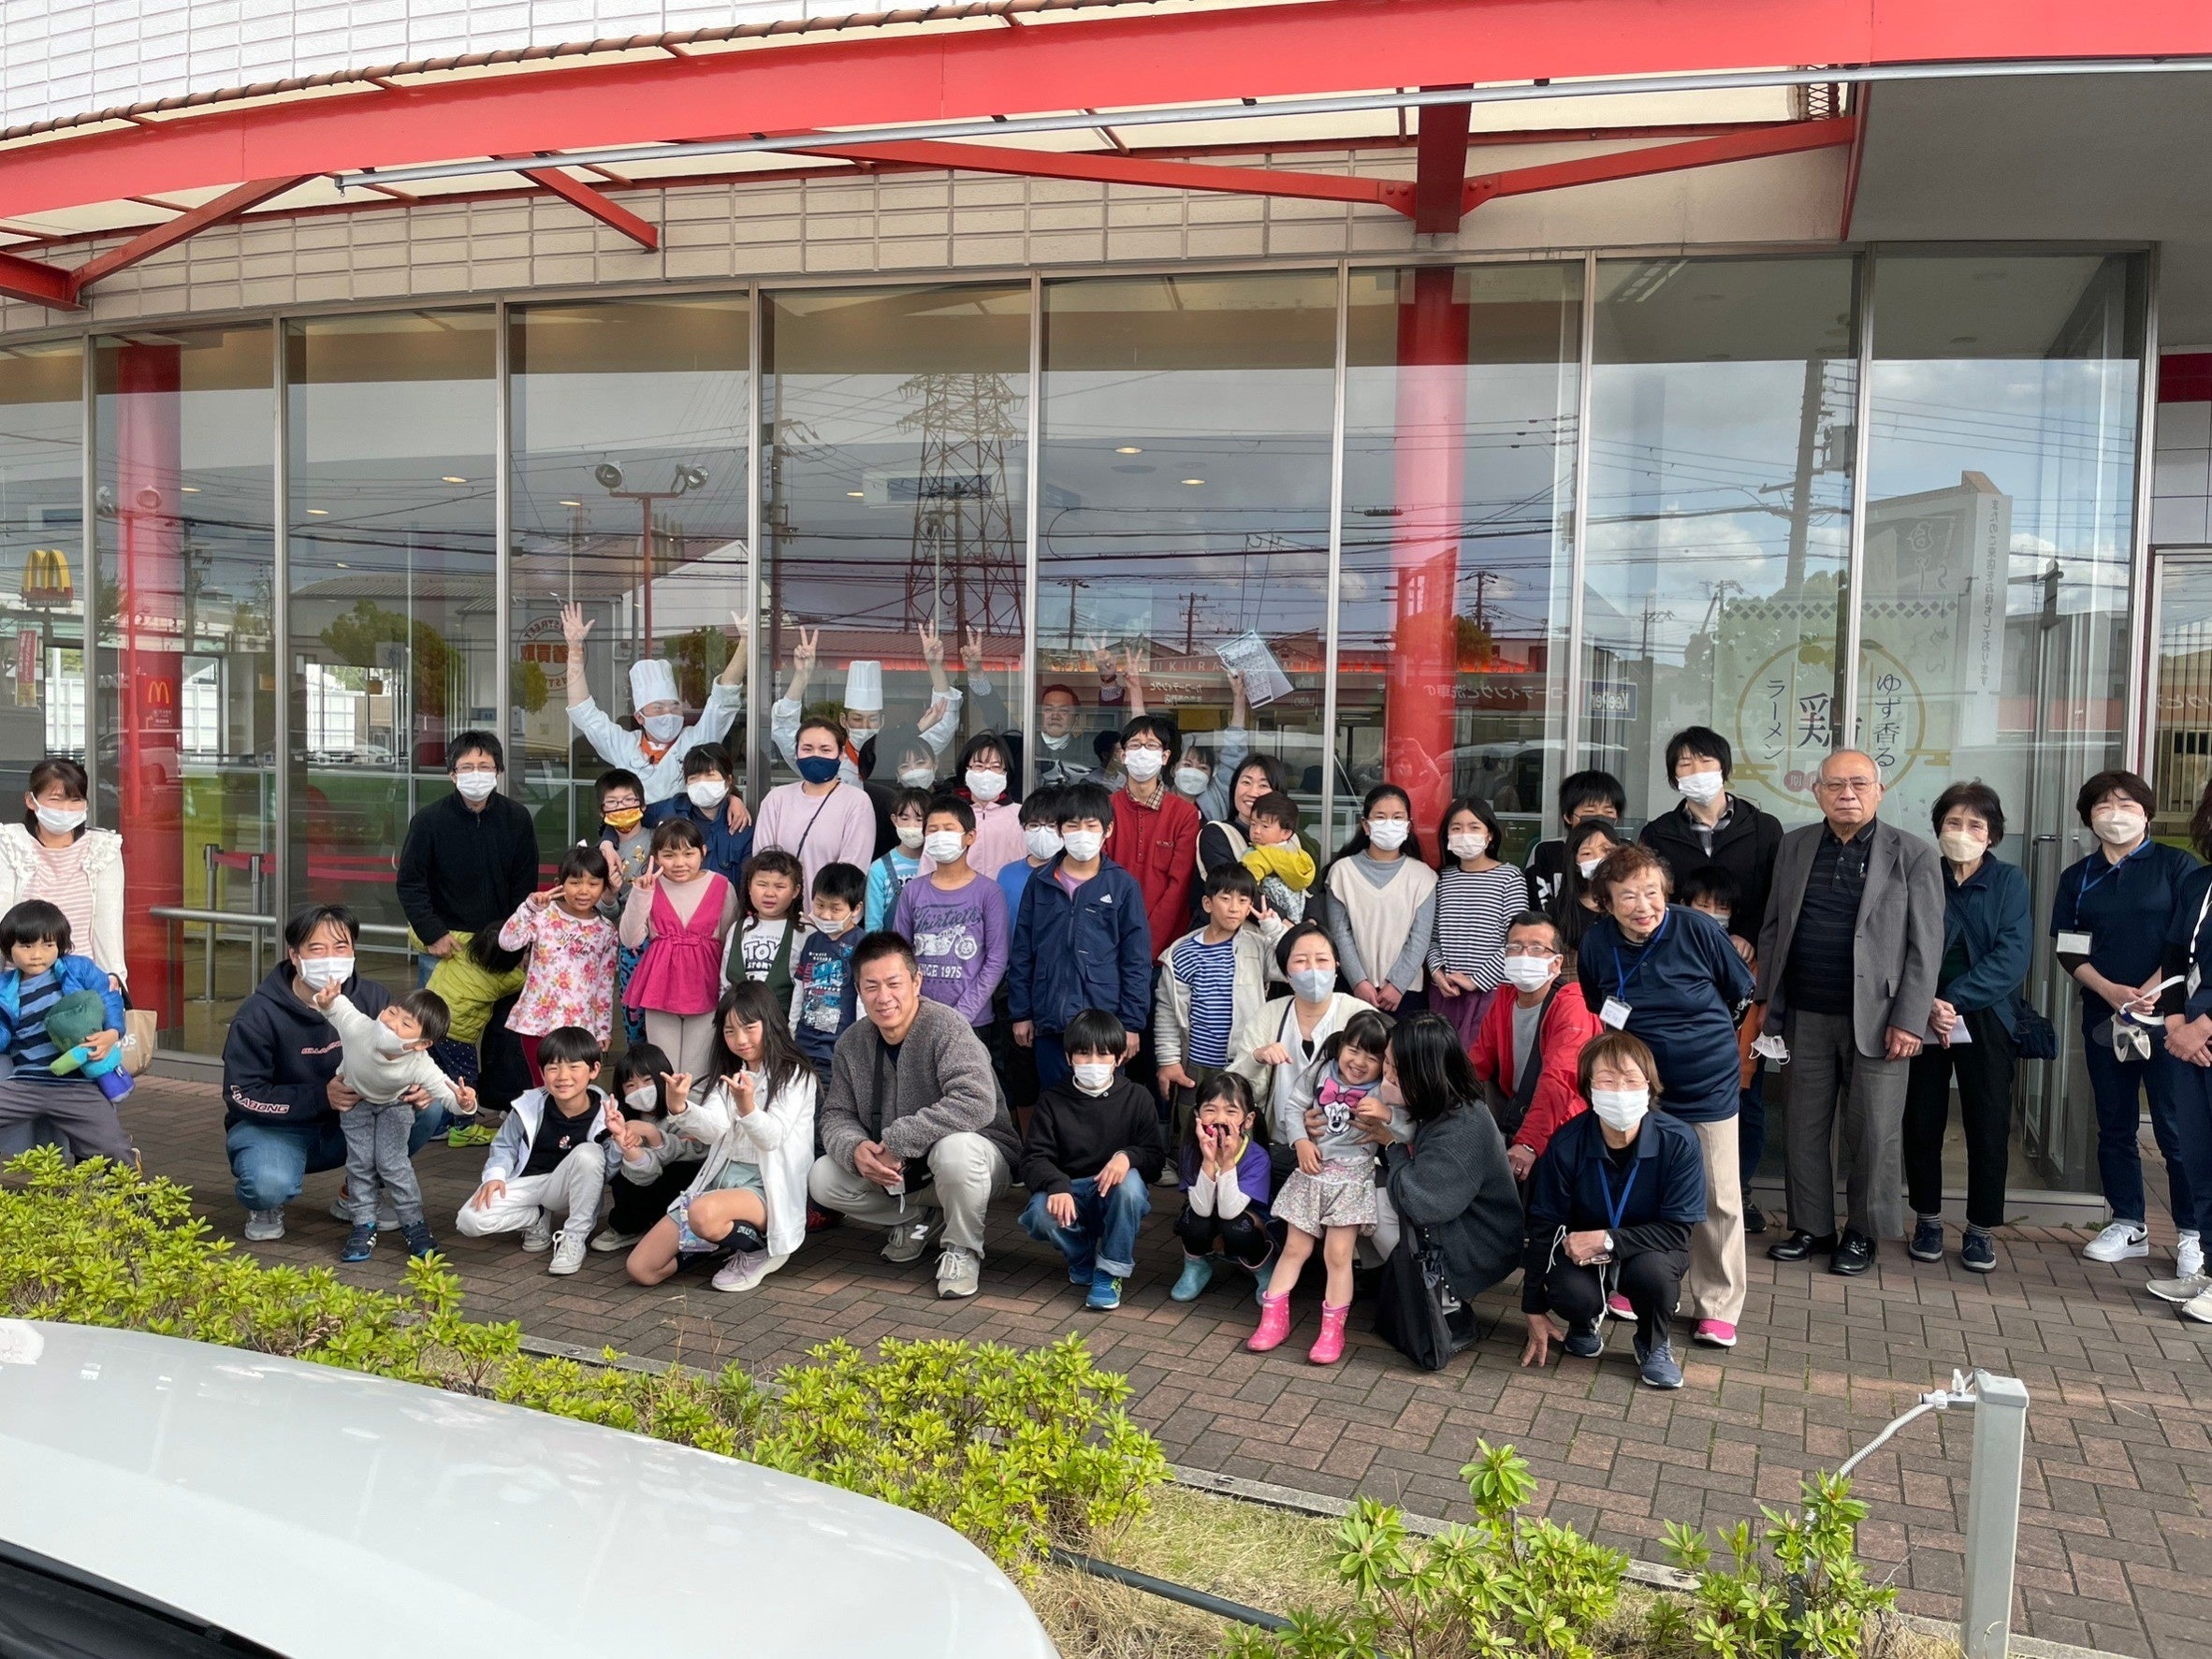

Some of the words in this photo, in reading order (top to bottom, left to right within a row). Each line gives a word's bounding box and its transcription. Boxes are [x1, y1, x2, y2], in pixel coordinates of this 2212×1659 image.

[1154, 661, 1220, 671] UKURA
[1763, 678, 1786, 761] ラーメン
[1873, 673, 1901, 767] ゆず香る
[744, 940, 780, 961] TOY
[747, 961, 773, 970] STORY
[940, 966, 963, 979] 1975
